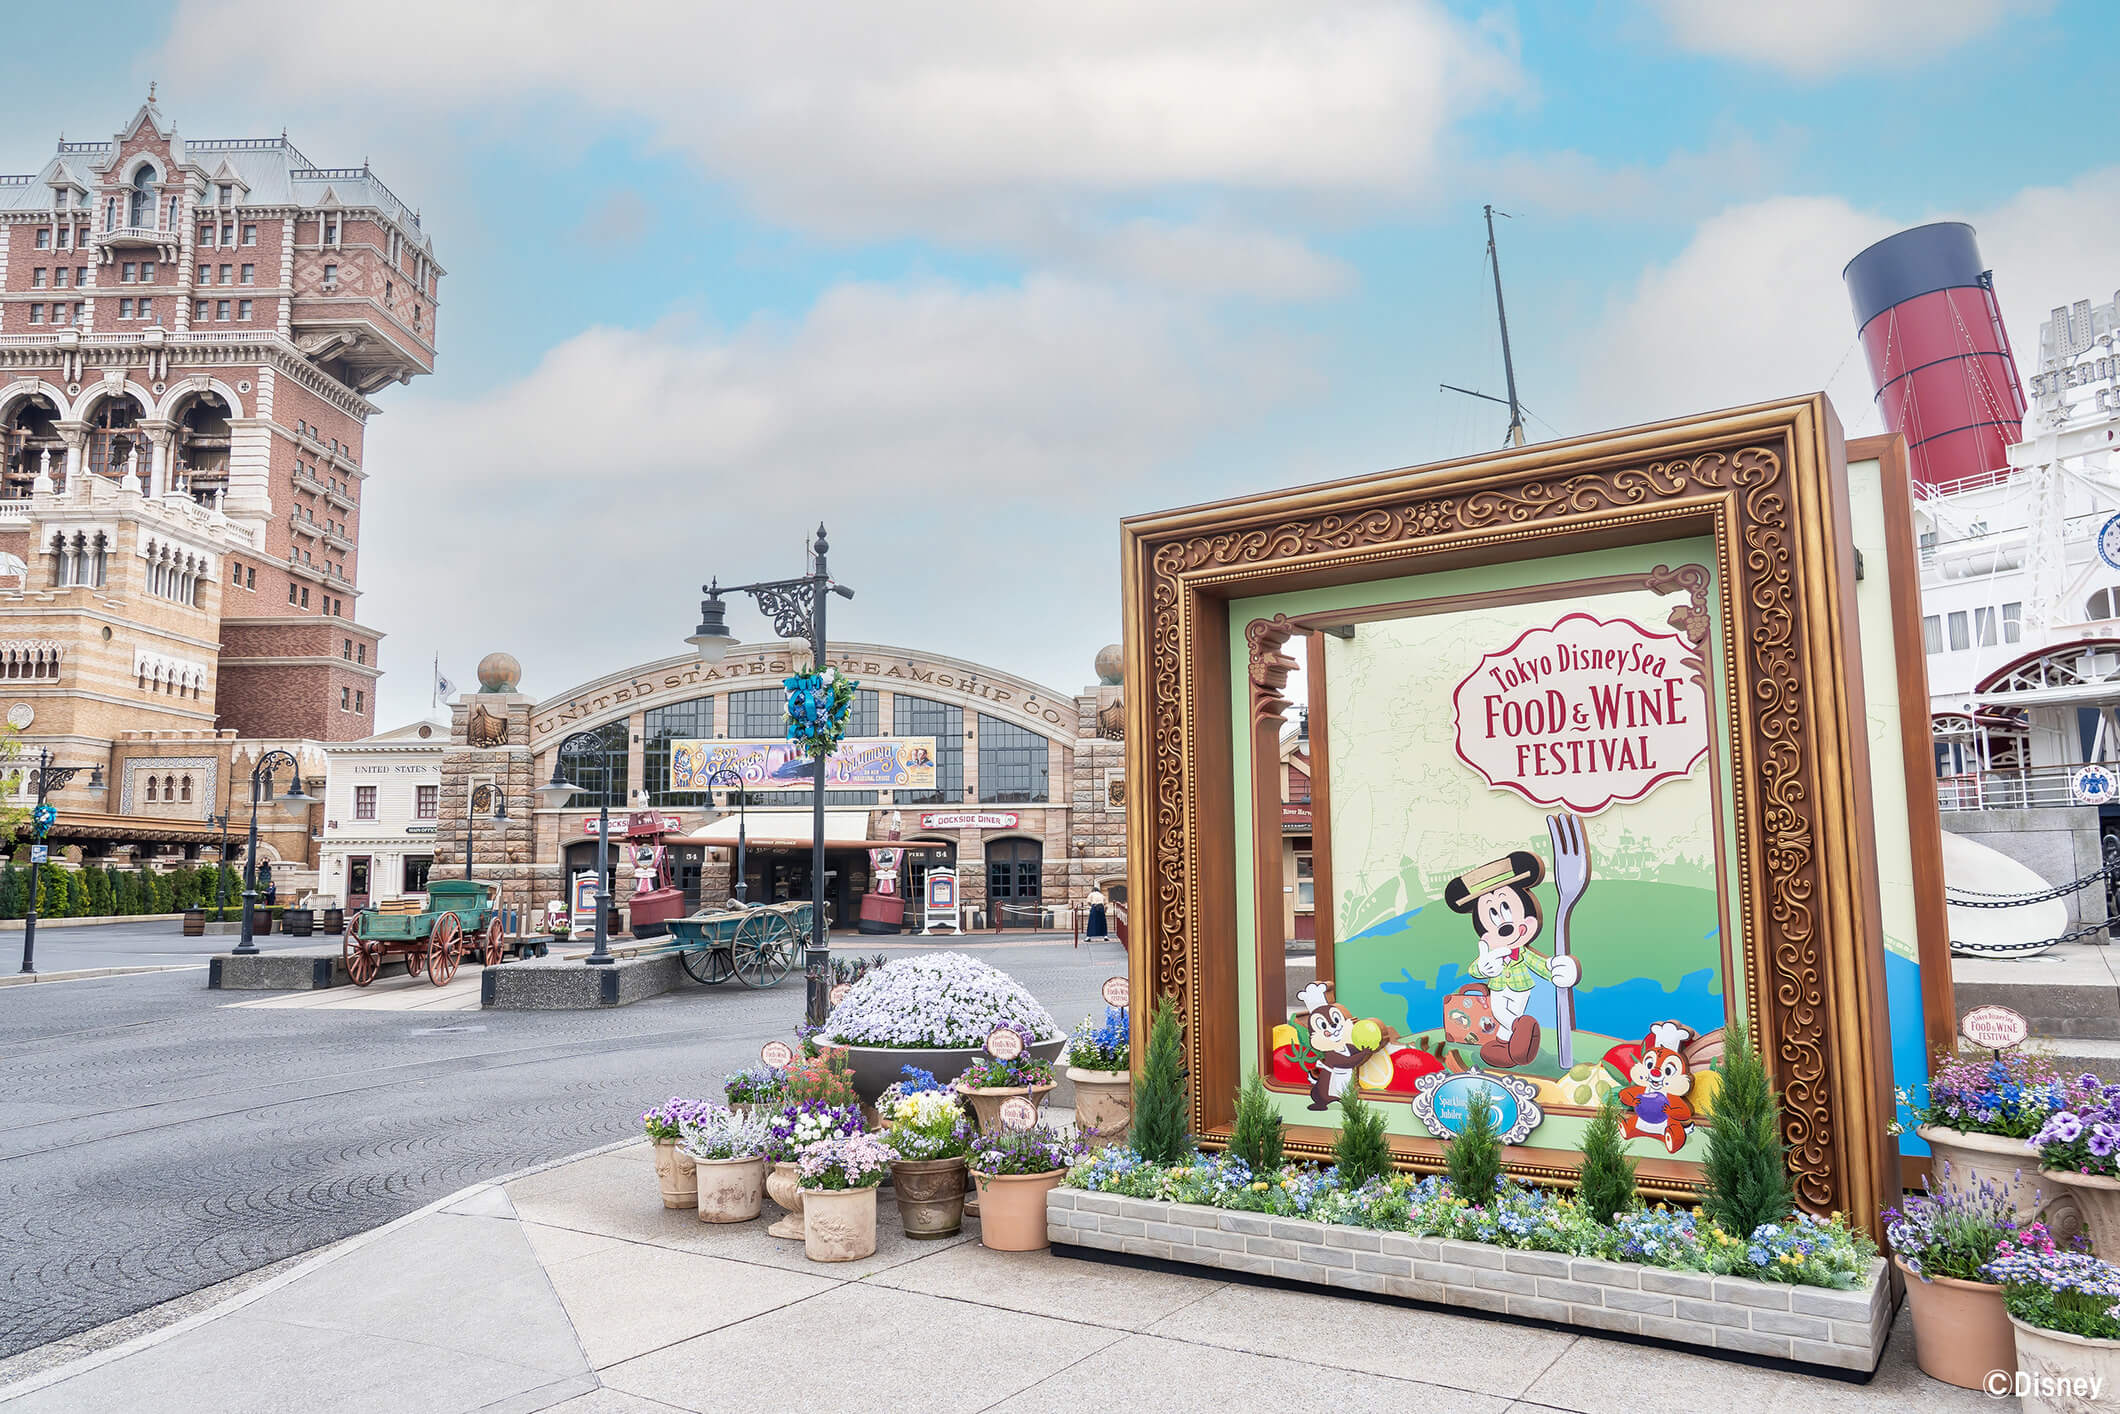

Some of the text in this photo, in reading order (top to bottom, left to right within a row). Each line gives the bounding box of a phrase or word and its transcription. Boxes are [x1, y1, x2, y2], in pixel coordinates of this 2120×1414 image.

[1489, 643, 1666, 693] Tokyo DisneySea
[534, 682, 656, 734] UNITED
[663, 661, 787, 689] STATES
[1023, 700, 1066, 727] CO.
[1483, 677, 1687, 739] FOOD & WINE
[1516, 736, 1657, 777] FESTIVAL
[354, 765, 390, 774] UNITED
[394, 765, 428, 774] STATES
[938, 815, 1001, 825] DOCKSIDE DINER
[1971, 1021, 1991, 1032] FOOD
[1996, 1022, 2018, 1033] WINE
[1978, 1032, 2011, 1041] FESTIVAL
[1438, 1095, 1467, 1108] Sparklin
[1440, 1108, 1462, 1119] Jubilee
